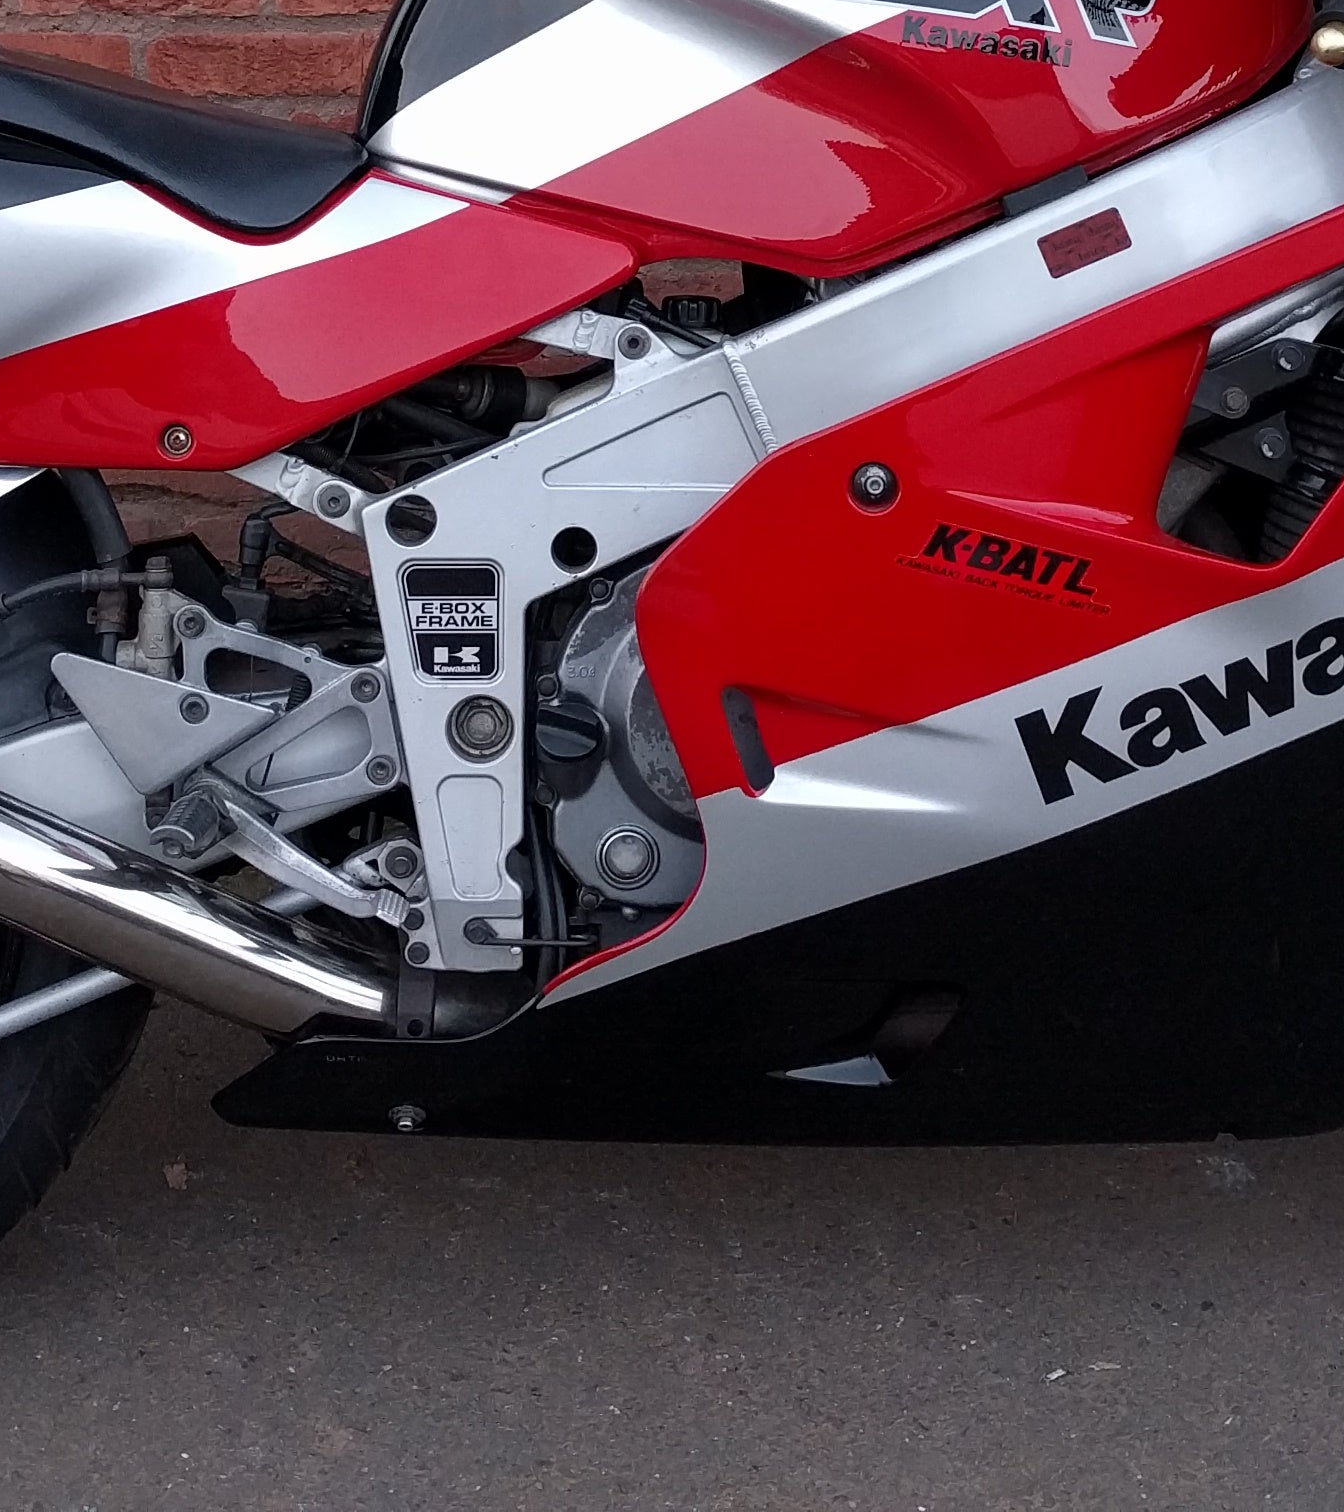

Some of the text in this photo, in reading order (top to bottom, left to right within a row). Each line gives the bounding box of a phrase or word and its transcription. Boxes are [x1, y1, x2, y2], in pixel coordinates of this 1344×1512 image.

[901, 15, 1073, 68] Kawasaki
[922, 522, 1097, 597] K-BATL
[416, 615, 493, 627] FRAME
[434, 664, 480, 673] Kawasaki
